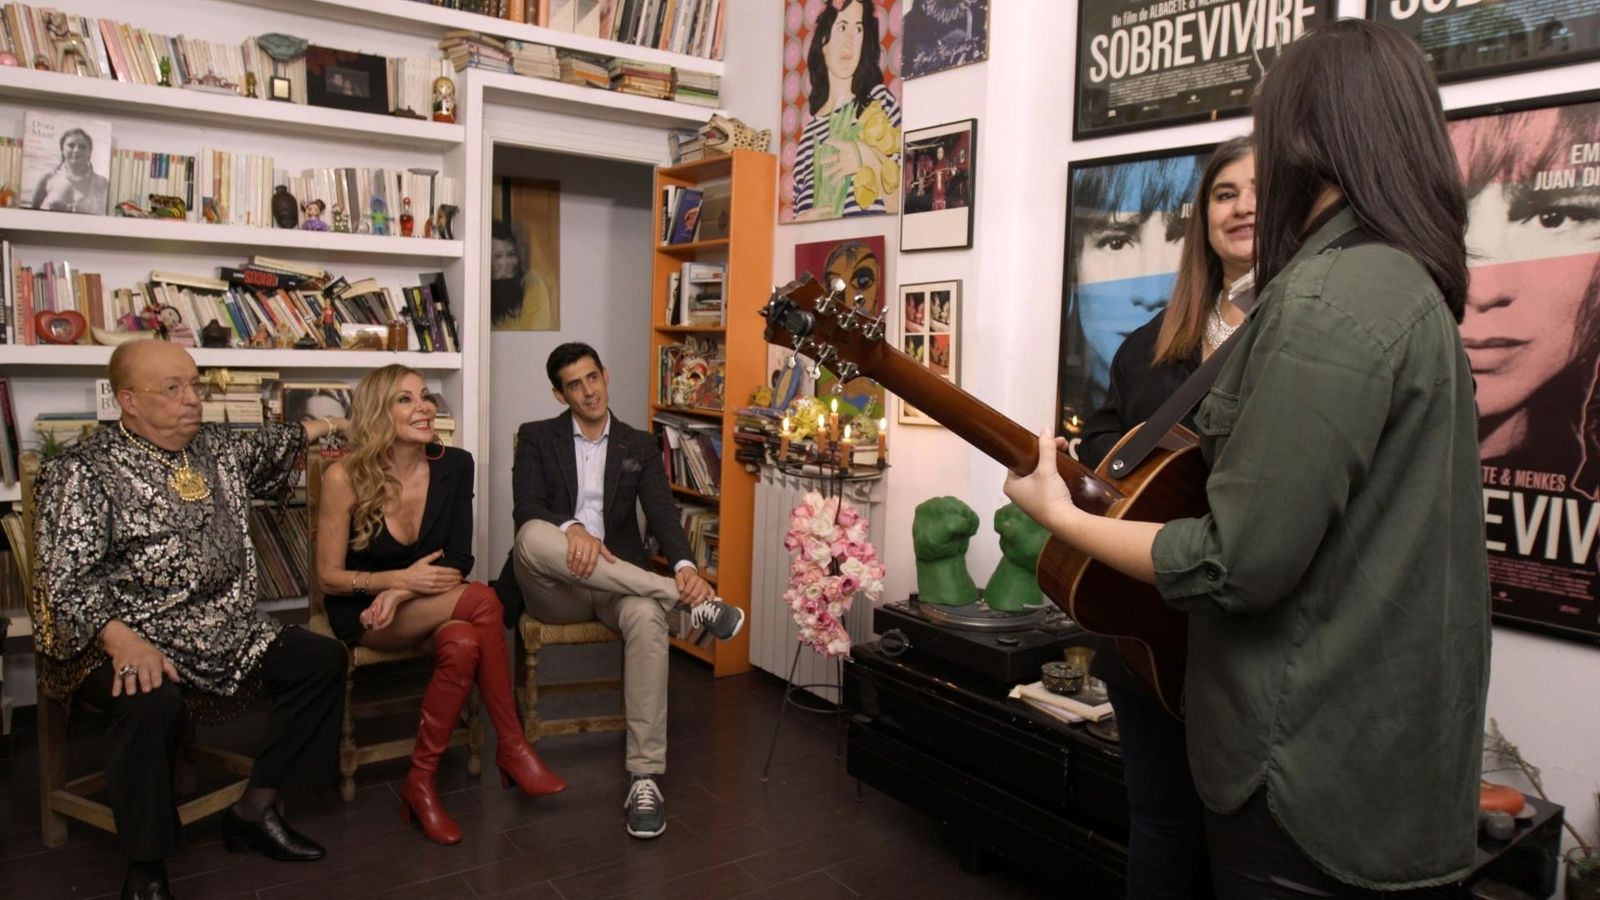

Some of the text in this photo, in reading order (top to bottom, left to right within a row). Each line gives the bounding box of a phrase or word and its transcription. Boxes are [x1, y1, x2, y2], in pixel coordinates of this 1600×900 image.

[1112, 15, 1122, 29] Un
[1122, 10, 1138, 26] film
[1139, 7, 1149, 21] de
[1149, 0, 1187, 18] ALBACETE
[1533, 168, 1576, 191] JUAN
[1501, 468, 1512, 486] &
[1515, 470, 1567, 492] MENKES
